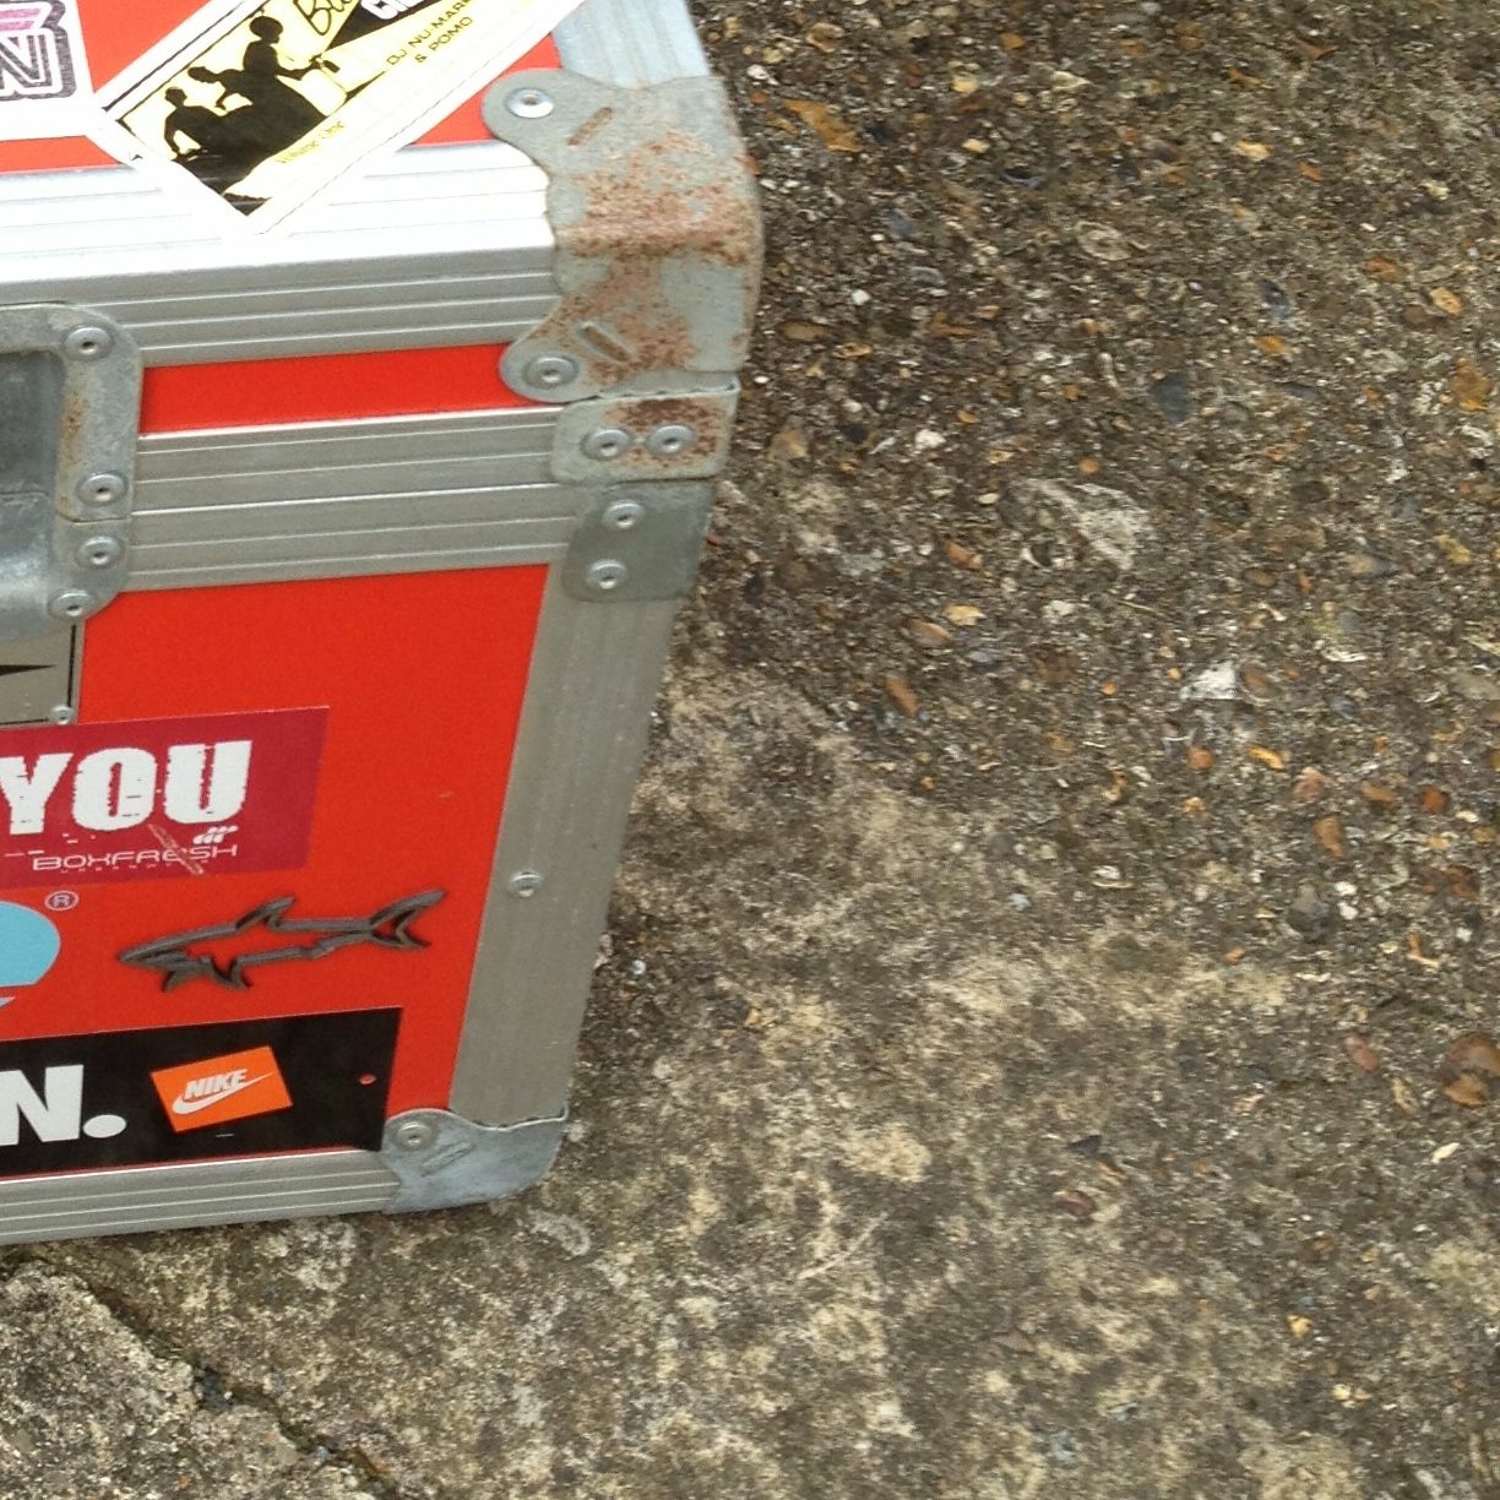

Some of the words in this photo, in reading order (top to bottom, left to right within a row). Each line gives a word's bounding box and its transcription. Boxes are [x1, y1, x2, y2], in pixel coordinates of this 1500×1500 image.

[428, 16, 474, 51] POMO
[386, 48, 408, 66] DJ
[33, 843, 238, 871] BOXFRESH
[184, 1068, 248, 1100] NIKE
